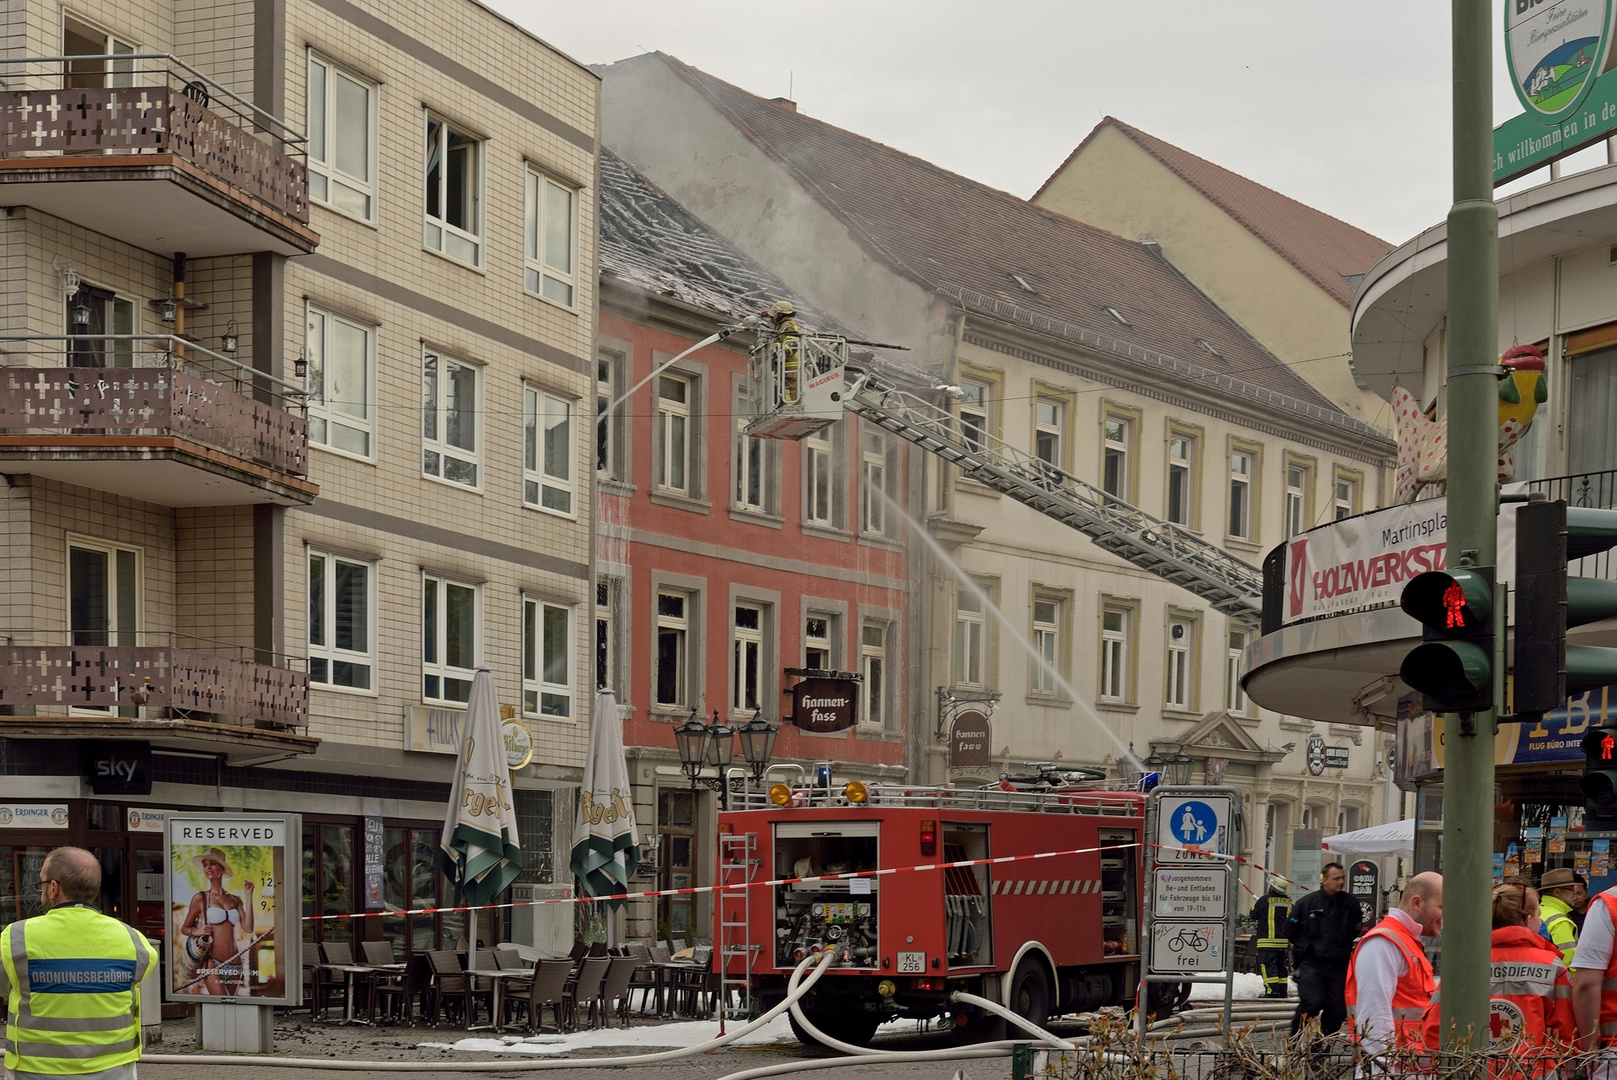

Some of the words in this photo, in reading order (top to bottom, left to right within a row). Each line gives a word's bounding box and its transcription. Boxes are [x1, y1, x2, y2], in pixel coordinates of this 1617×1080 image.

[1545, 7, 1567, 25] Feine
[1508, 122, 1578, 164] willkommen
[1584, 111, 1597, 129] in
[1602, 101, 1617, 121] de
[809, 372, 840, 389] MAGIRUS
[1382, 512, 1447, 548] Martinspla
[1313, 597, 1358, 611] Manufaktur
[1371, 590, 1388, 599] für
[811, 709, 837, 723] fass
[1529, 741, 1545, 750] FLUG
[1546, 740, 1565, 749] BÜRO
[1566, 739, 1582, 748] INTE
[98, 755, 138, 781] sky
[15, 808, 49, 817] ERDINGER
[141, 812, 164, 820] ERDINGER
[183, 827, 274, 839] RESERVED
[1190, 884, 1216, 892] Entladen
[1169, 894, 1200, 903] Fahrzeuge
[1186, 904, 1207, 912] 19-11h
[905, 953, 918, 962] KL
[1176, 954, 1200, 966] frei
[902, 962, 920, 971] 256
[32, 969, 133, 983] ORDNUNGSBEHÖRDE
